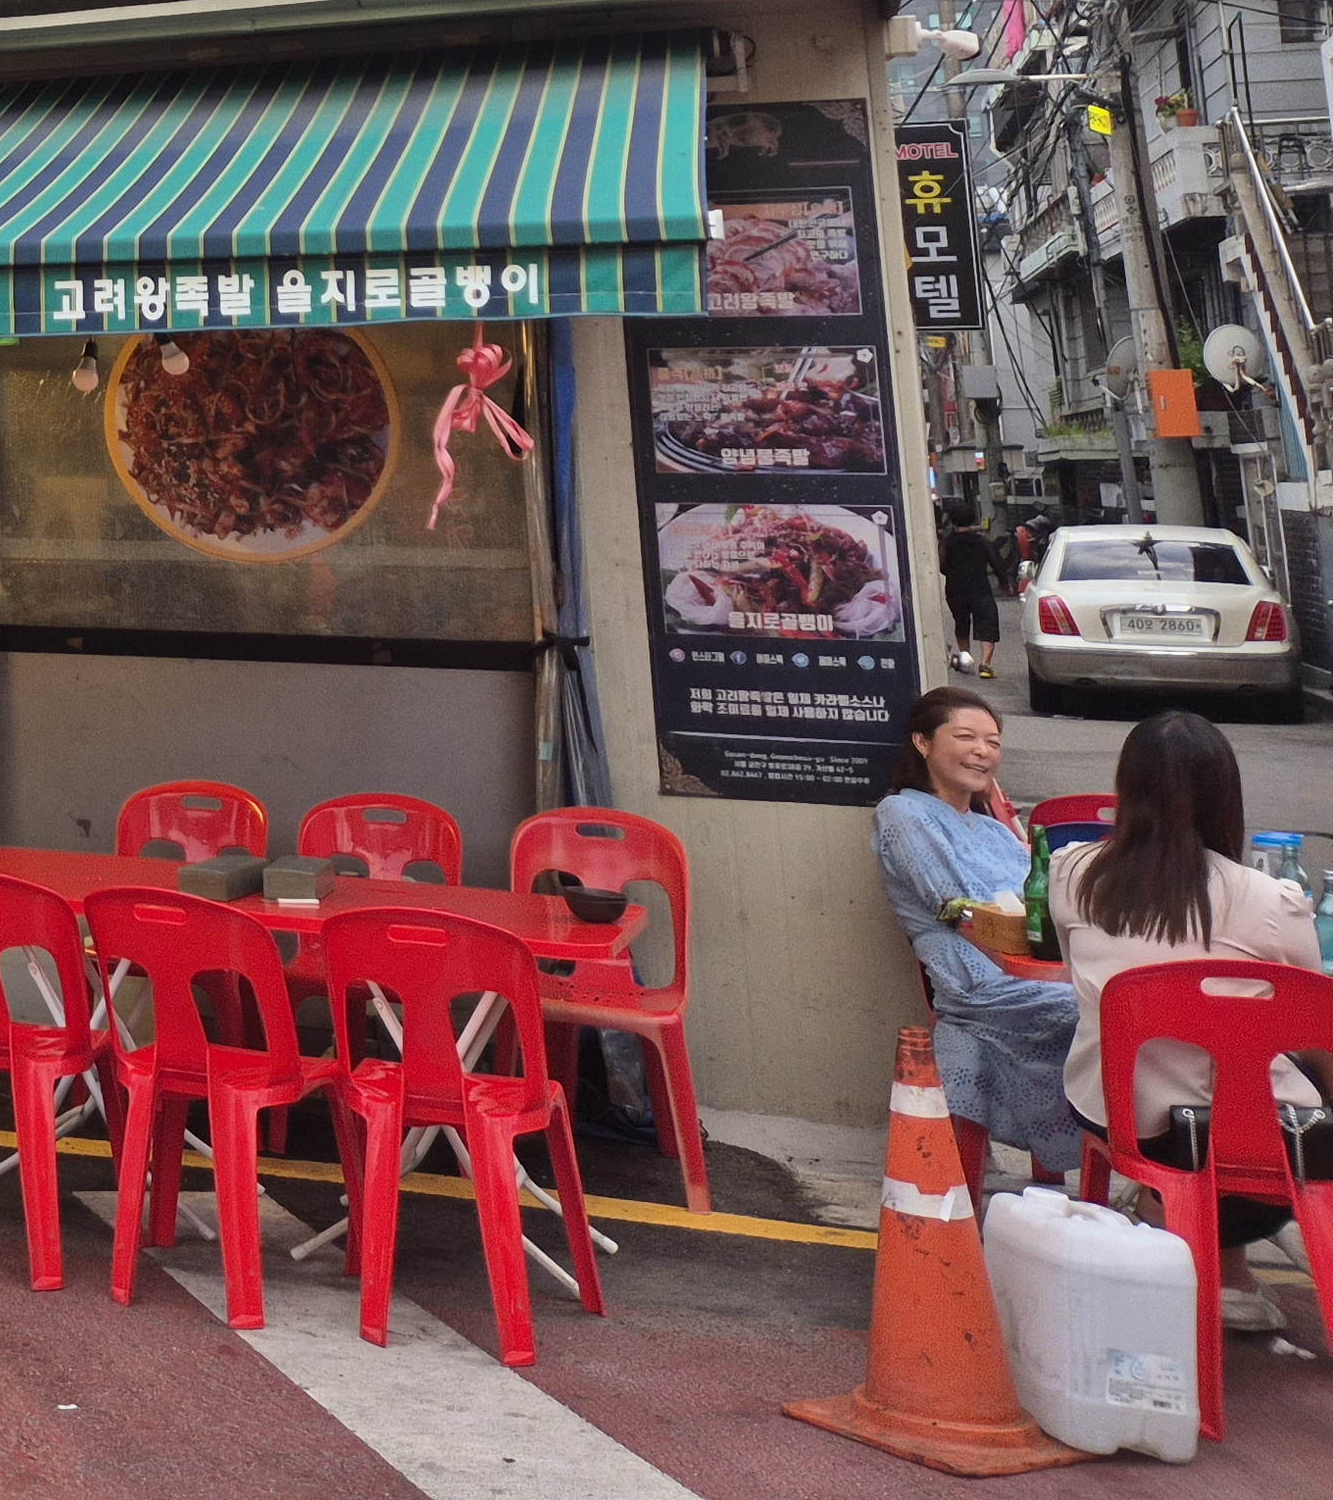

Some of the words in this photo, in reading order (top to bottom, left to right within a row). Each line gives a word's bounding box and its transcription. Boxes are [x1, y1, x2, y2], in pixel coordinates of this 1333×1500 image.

[895, 141, 959, 160] MOTEL
[52, 272, 254, 321] 고려왕족발
[276, 263, 539, 312] 을지로골뱅이
[728, 611, 834, 631] 을지로골뱅이
[1160, 618, 1196, 631] 2860
